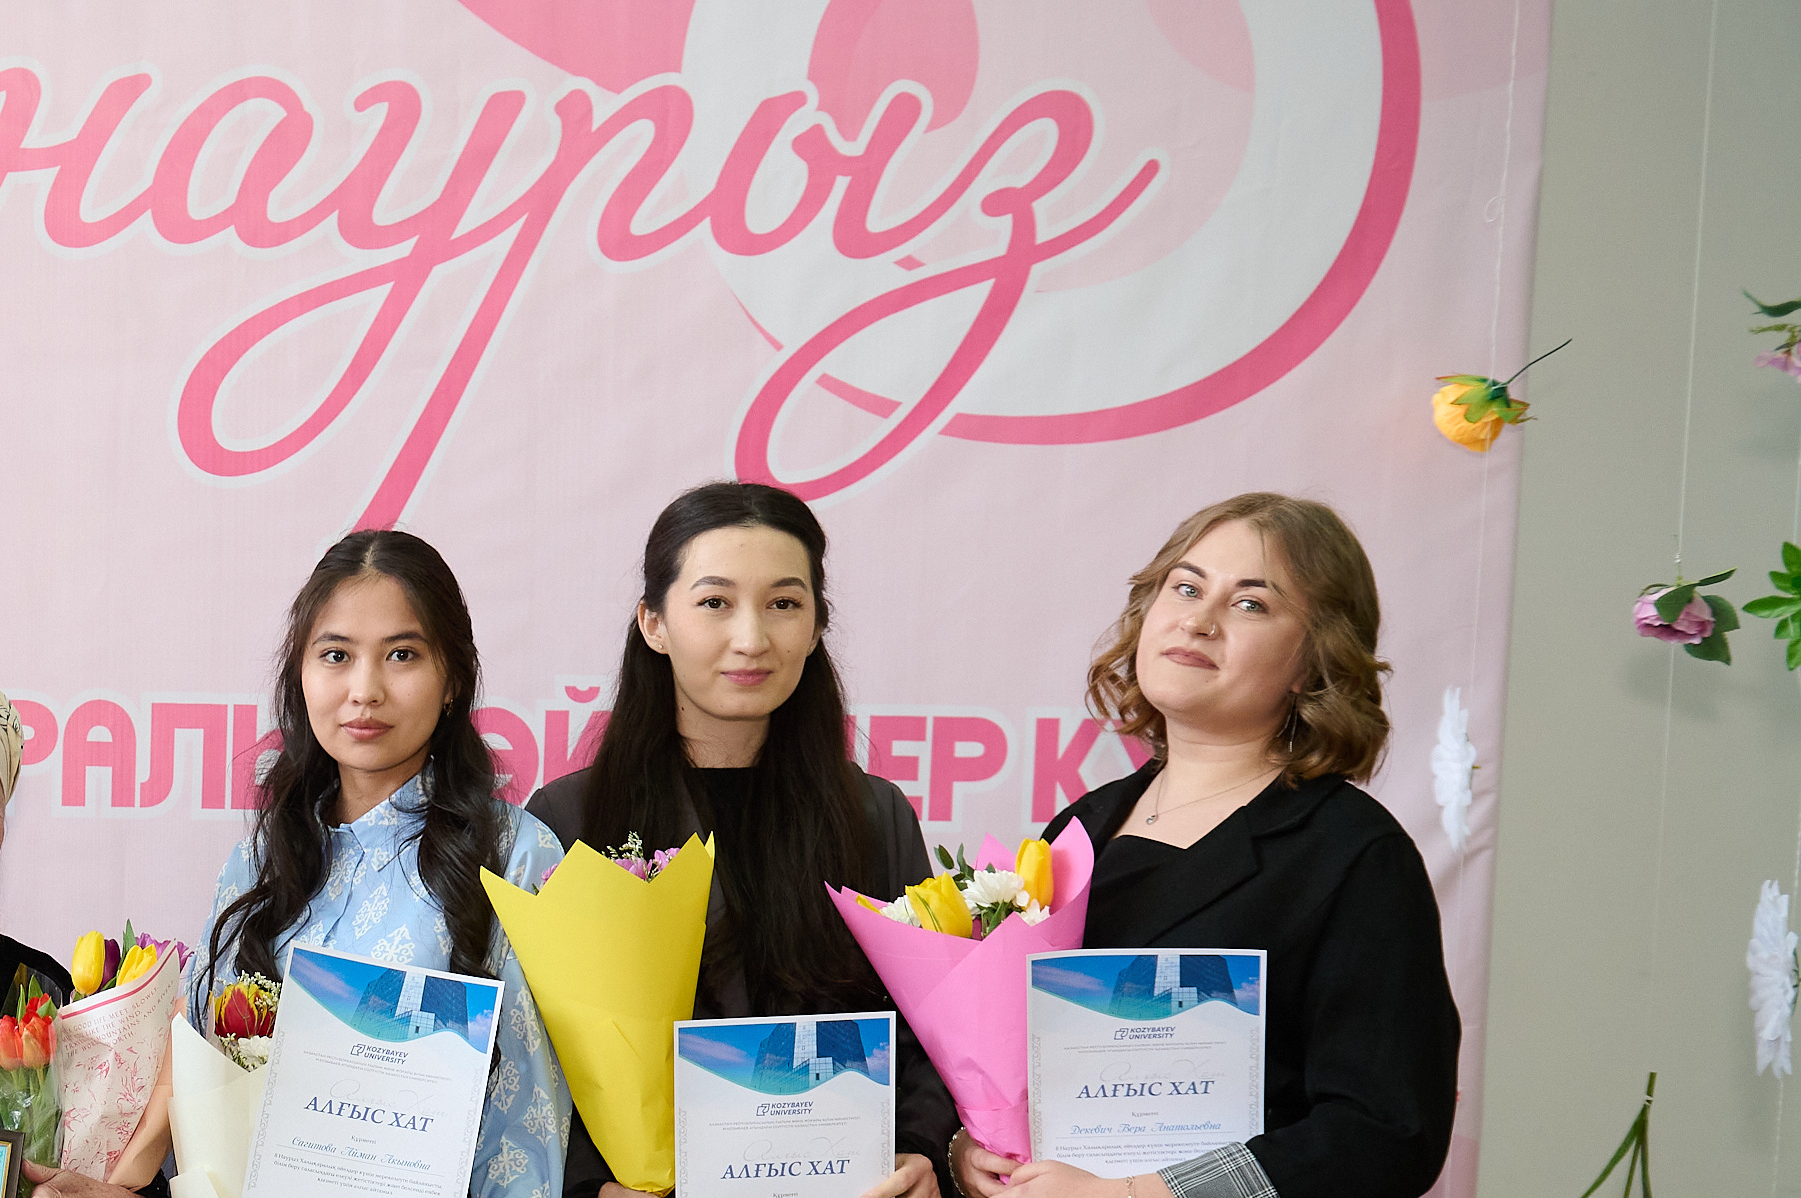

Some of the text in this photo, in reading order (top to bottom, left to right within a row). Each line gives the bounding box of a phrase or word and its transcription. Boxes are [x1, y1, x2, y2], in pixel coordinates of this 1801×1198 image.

[1129, 1032, 1174, 1040] UNIVERSITY
[365, 1045, 409, 1058] KOZYBAYEV
[364, 1052, 406, 1065] UNIVERSITY
[1075, 1080, 1215, 1099] АЛҒЫС ХАТ
[771, 1101, 814, 1109] KOZYBAYEV
[303, 1096, 385, 1124] АЛҒЫС
[387, 1111, 434, 1132] ХАТ
[770, 1108, 813, 1116] UNIVERSITY
[720, 1159, 850, 1179] АЛҒЫС ХАТ
